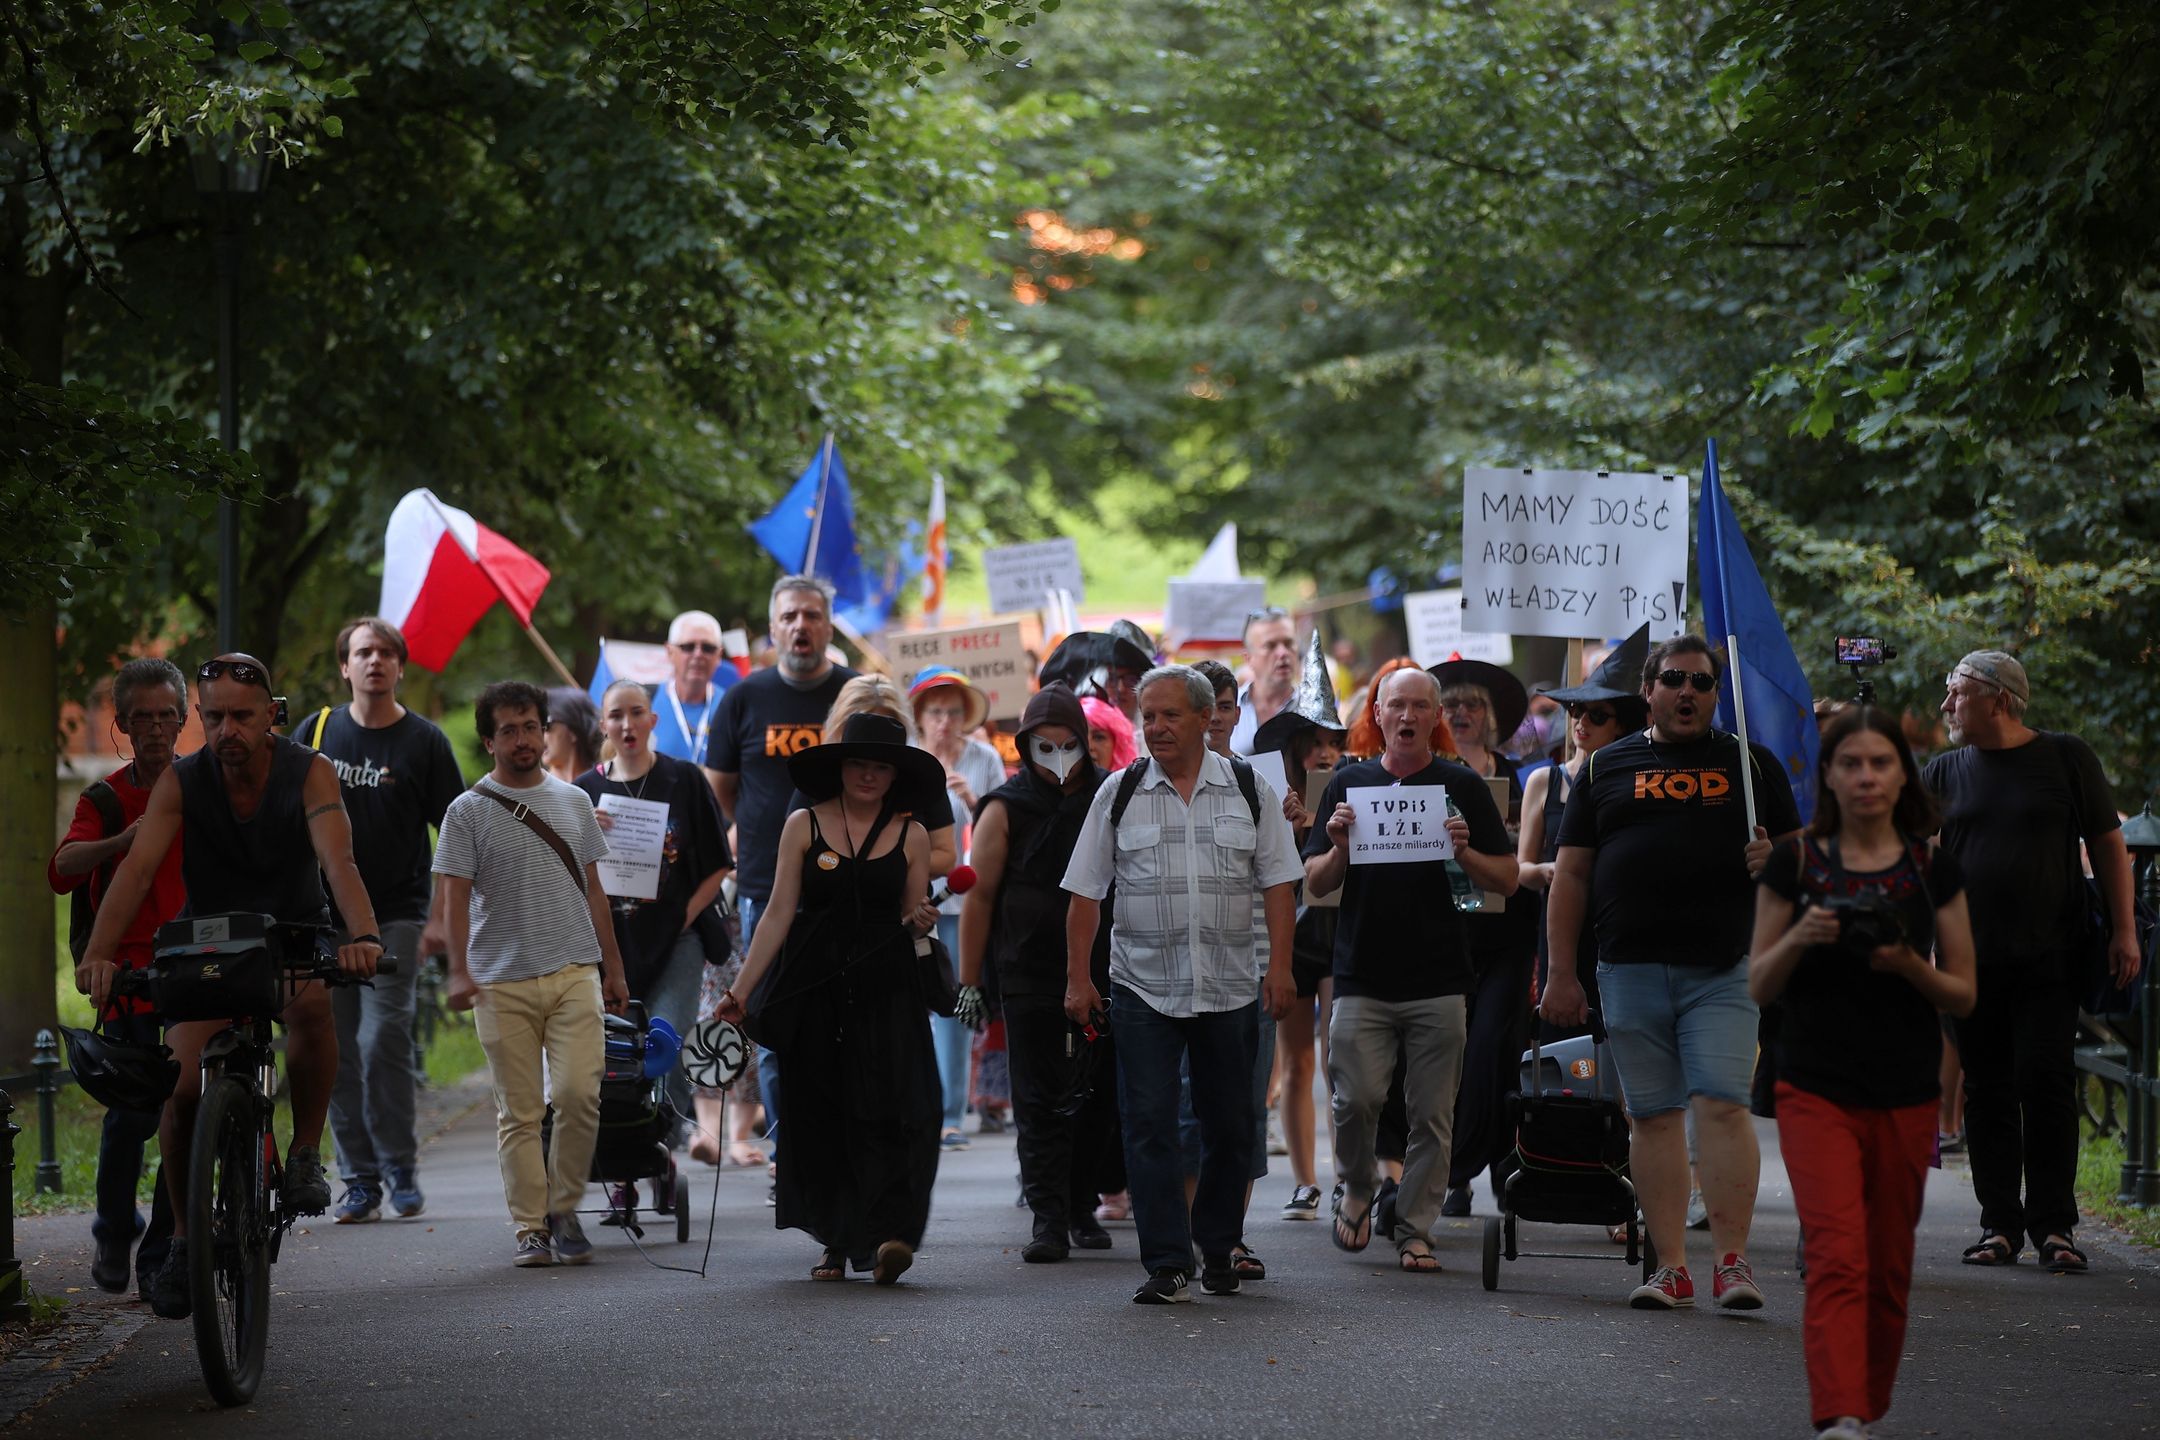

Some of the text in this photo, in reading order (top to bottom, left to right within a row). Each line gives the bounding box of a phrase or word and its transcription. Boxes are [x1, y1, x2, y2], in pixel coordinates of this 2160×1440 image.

[1481, 491, 1670, 532] MAMY DOŚĆ
[1483, 540, 1621, 567] AROGANCJI
[1485, 584, 1597, 617] WŁADZY
[765, 728, 826, 757] KO
[1635, 772, 1729, 799] KOD
[1356, 839, 1446, 852] za nasze miliardy
[1578, 1059, 1590, 1078] KOD
